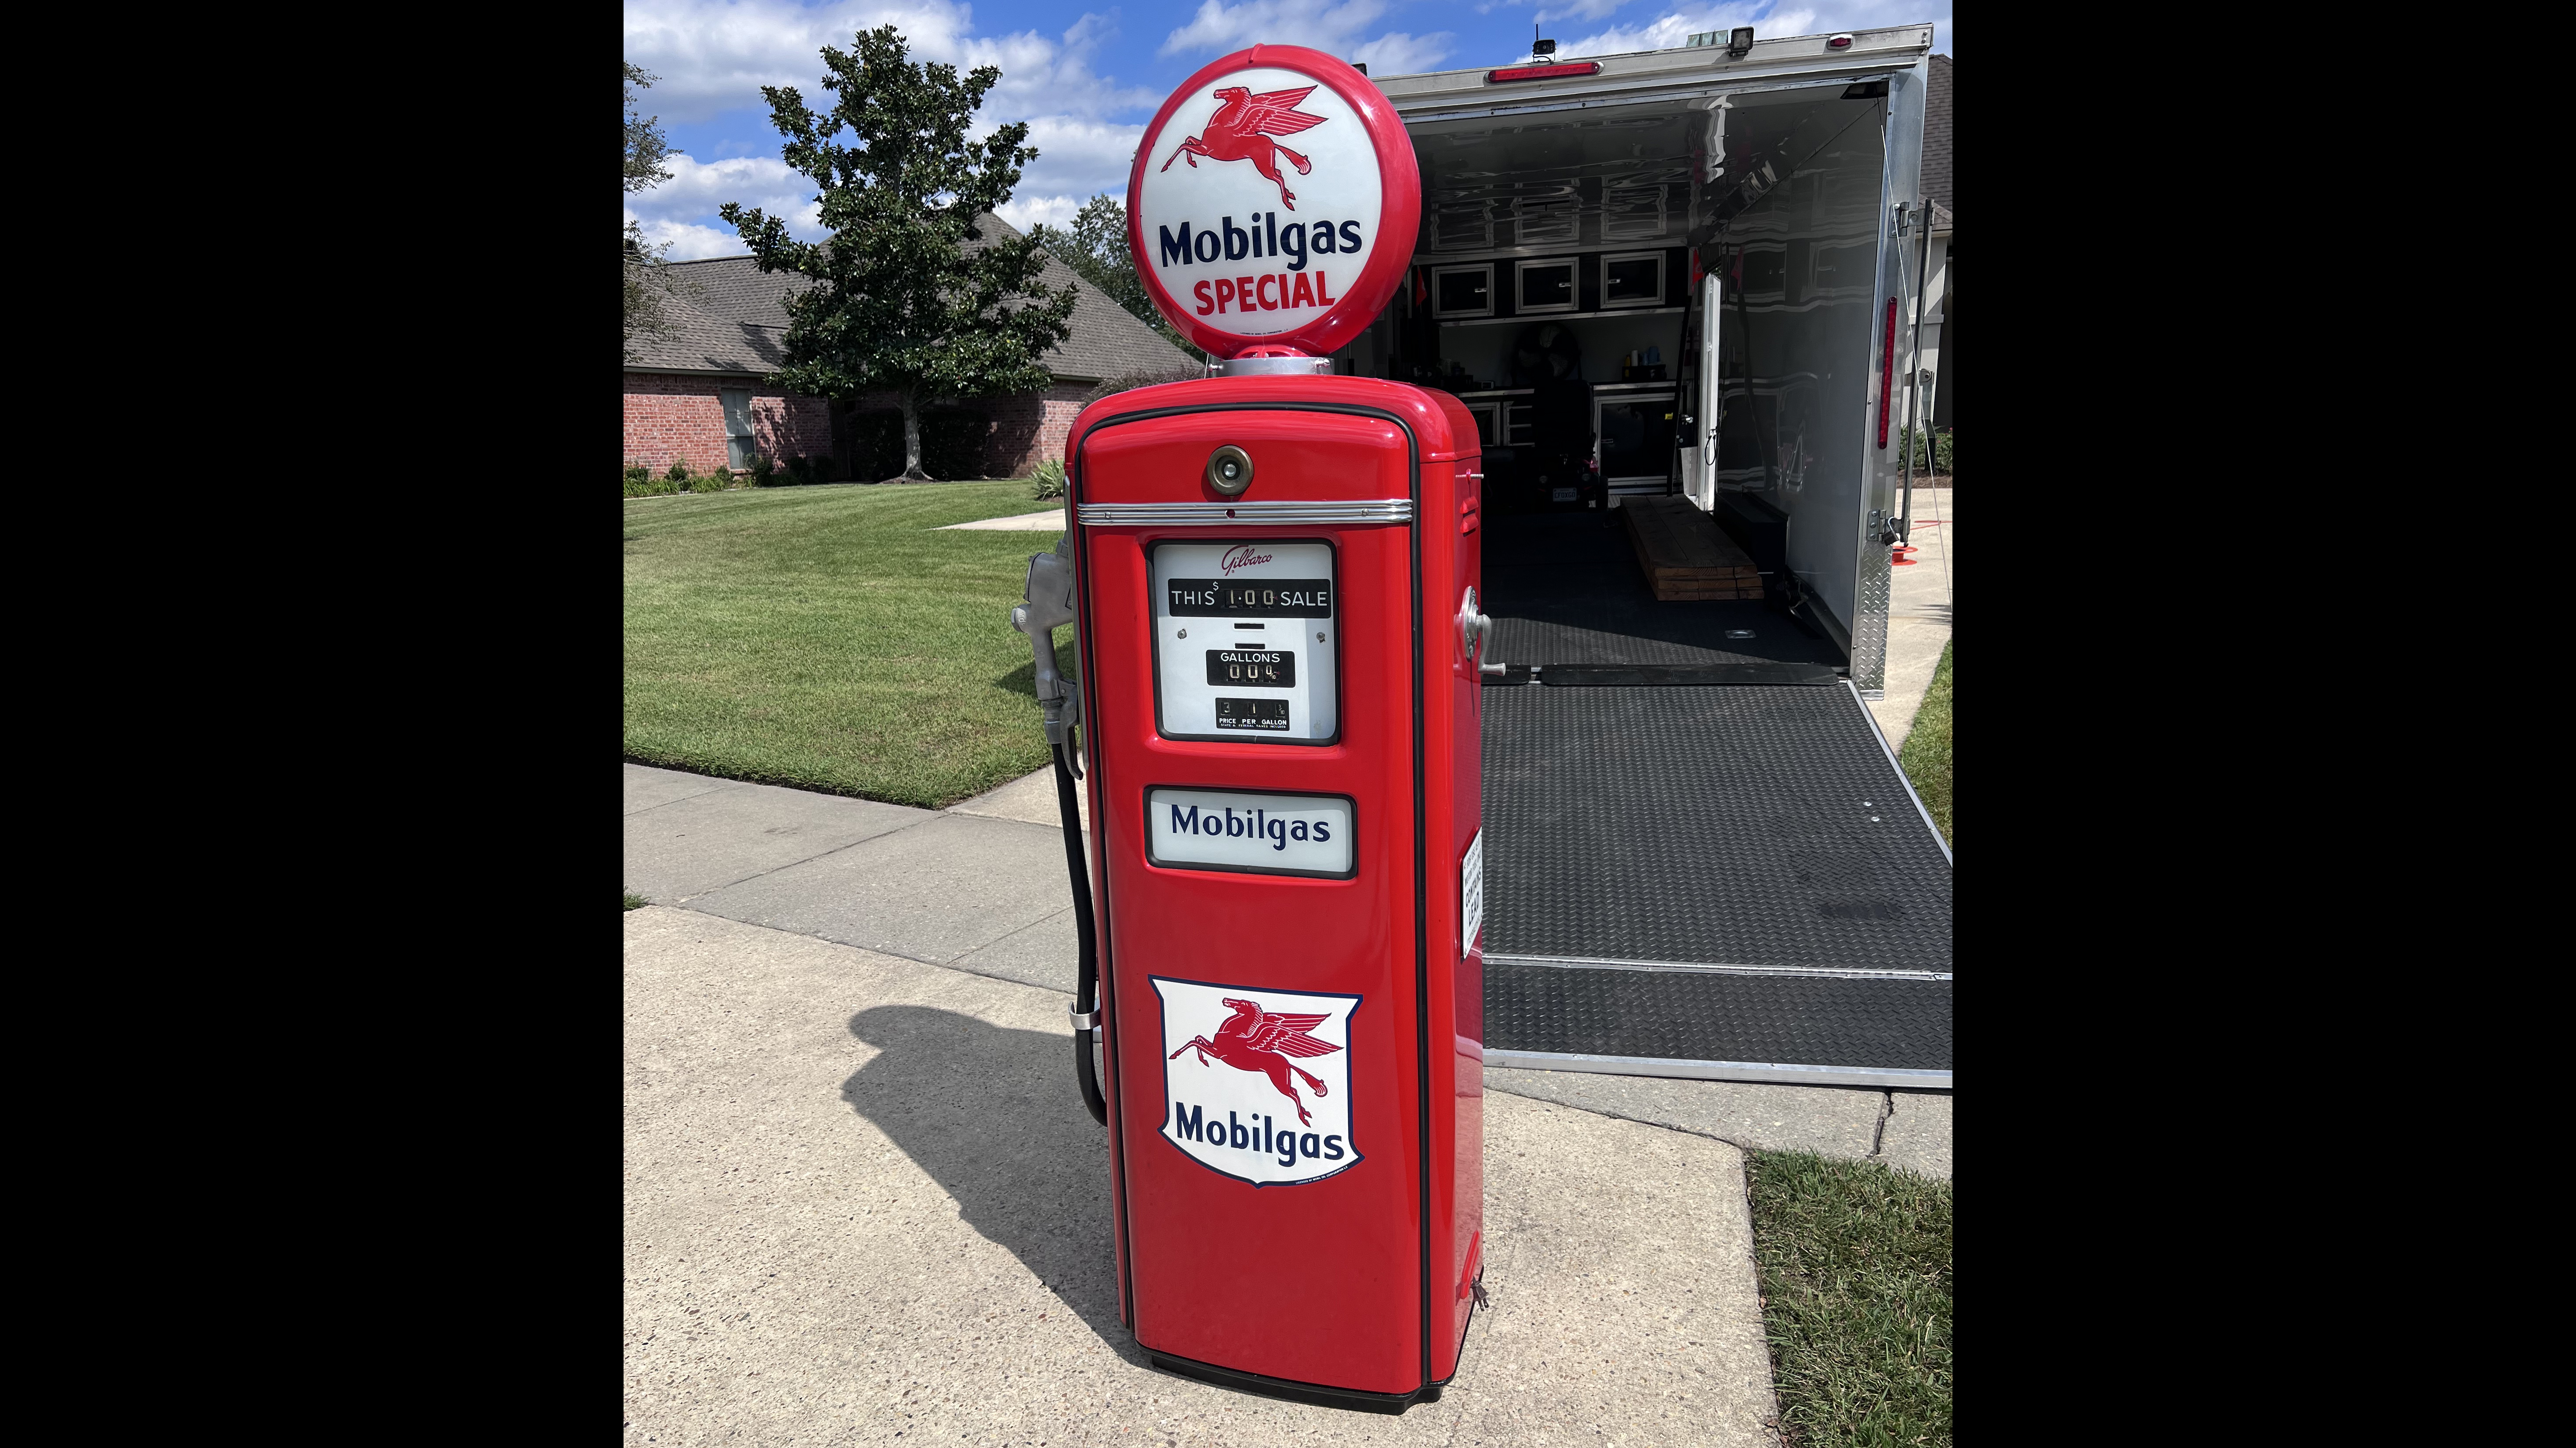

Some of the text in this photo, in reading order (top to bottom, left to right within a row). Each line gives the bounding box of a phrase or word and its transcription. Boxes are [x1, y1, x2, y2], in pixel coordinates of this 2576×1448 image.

[1159, 211, 1362, 271] Mobilgas
[1193, 271, 1336, 316] SPECIAL
[1221, 545, 1273, 576] Gilbarco
[1171, 590, 1215, 606] THIS
[1213, 581, 1219, 591] $
[1280, 591, 1328, 607] SALE
[1220, 652, 1280, 662] GALLONS
[1171, 804, 1331, 851] Mobilgas
[1466, 866, 1481, 908] CONTAINS
[1469, 891, 1480, 927] LEAD
[1176, 1101, 1345, 1167] Mobilgas
